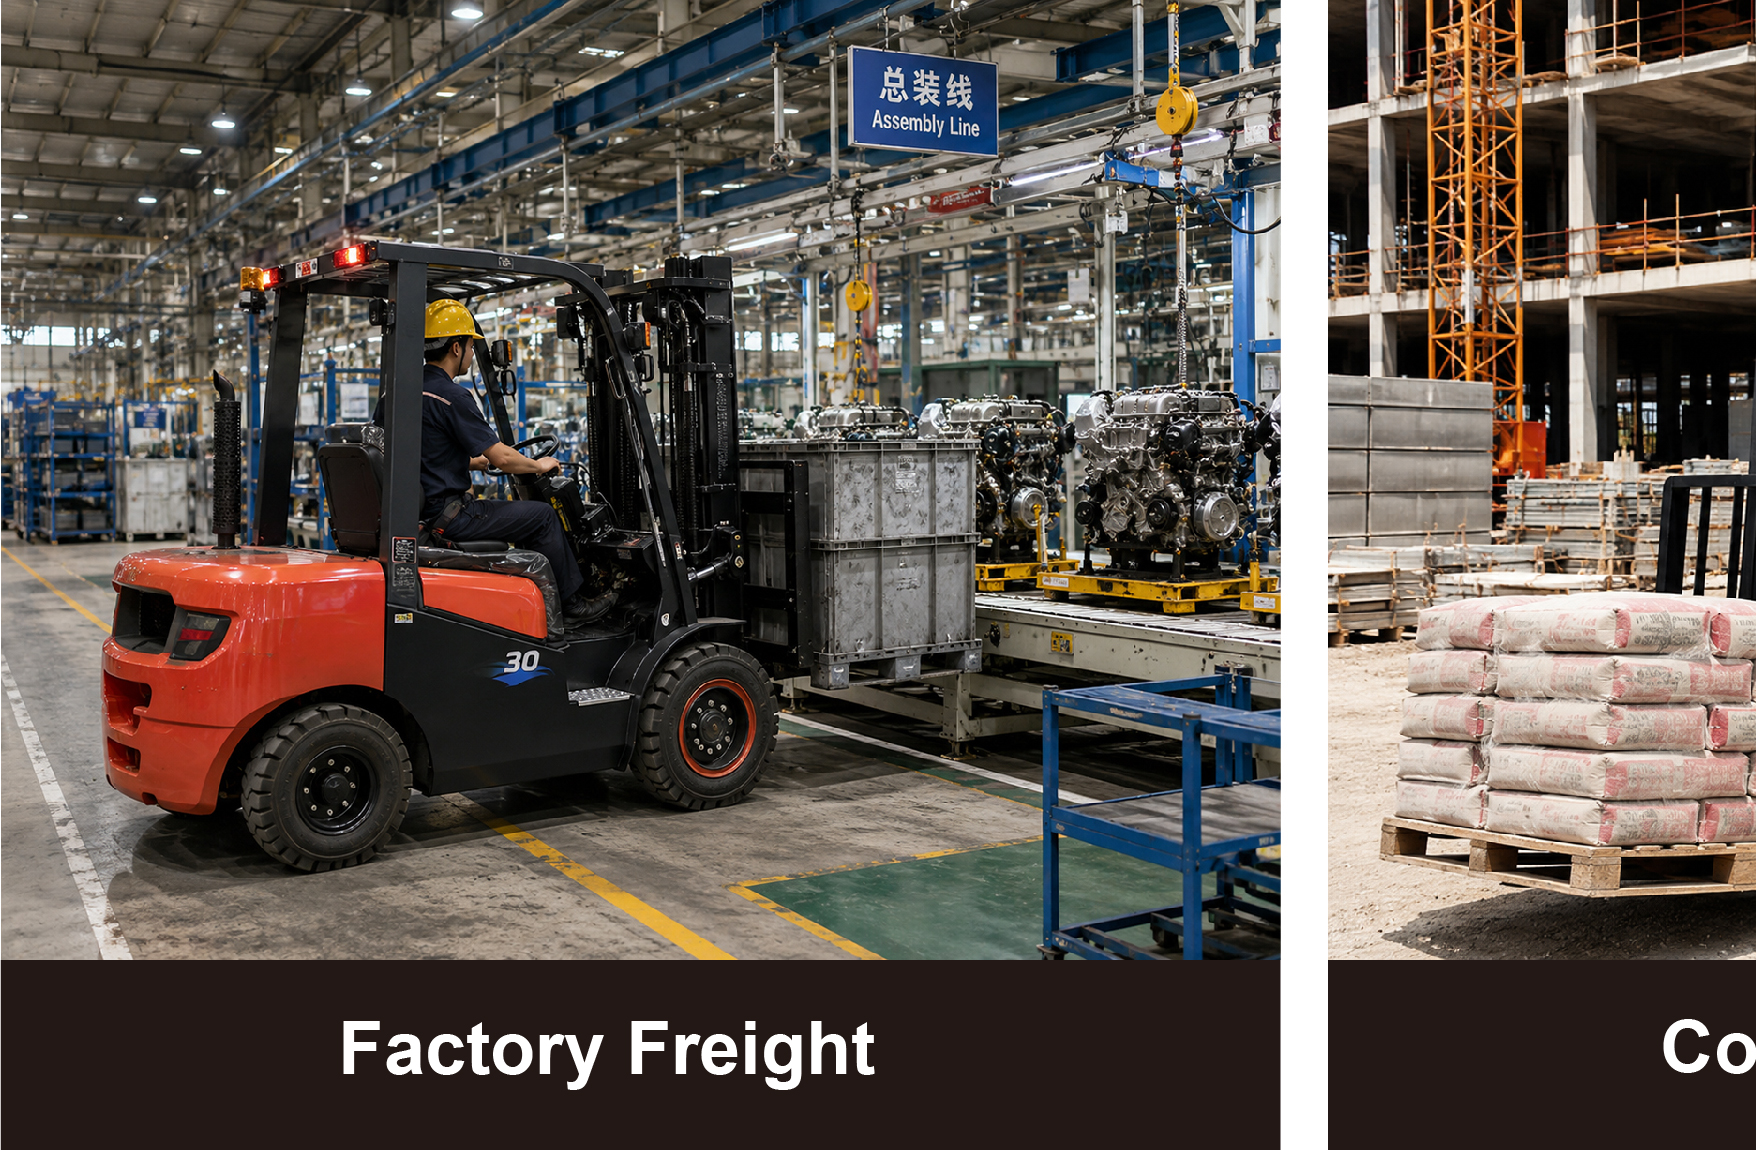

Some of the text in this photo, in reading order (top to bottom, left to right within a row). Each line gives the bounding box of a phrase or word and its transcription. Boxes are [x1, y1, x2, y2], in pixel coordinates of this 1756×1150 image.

[879, 65, 974, 112] 总装线
[872, 109, 981, 139] Assembly Line
[503, 650, 540, 673] 30
